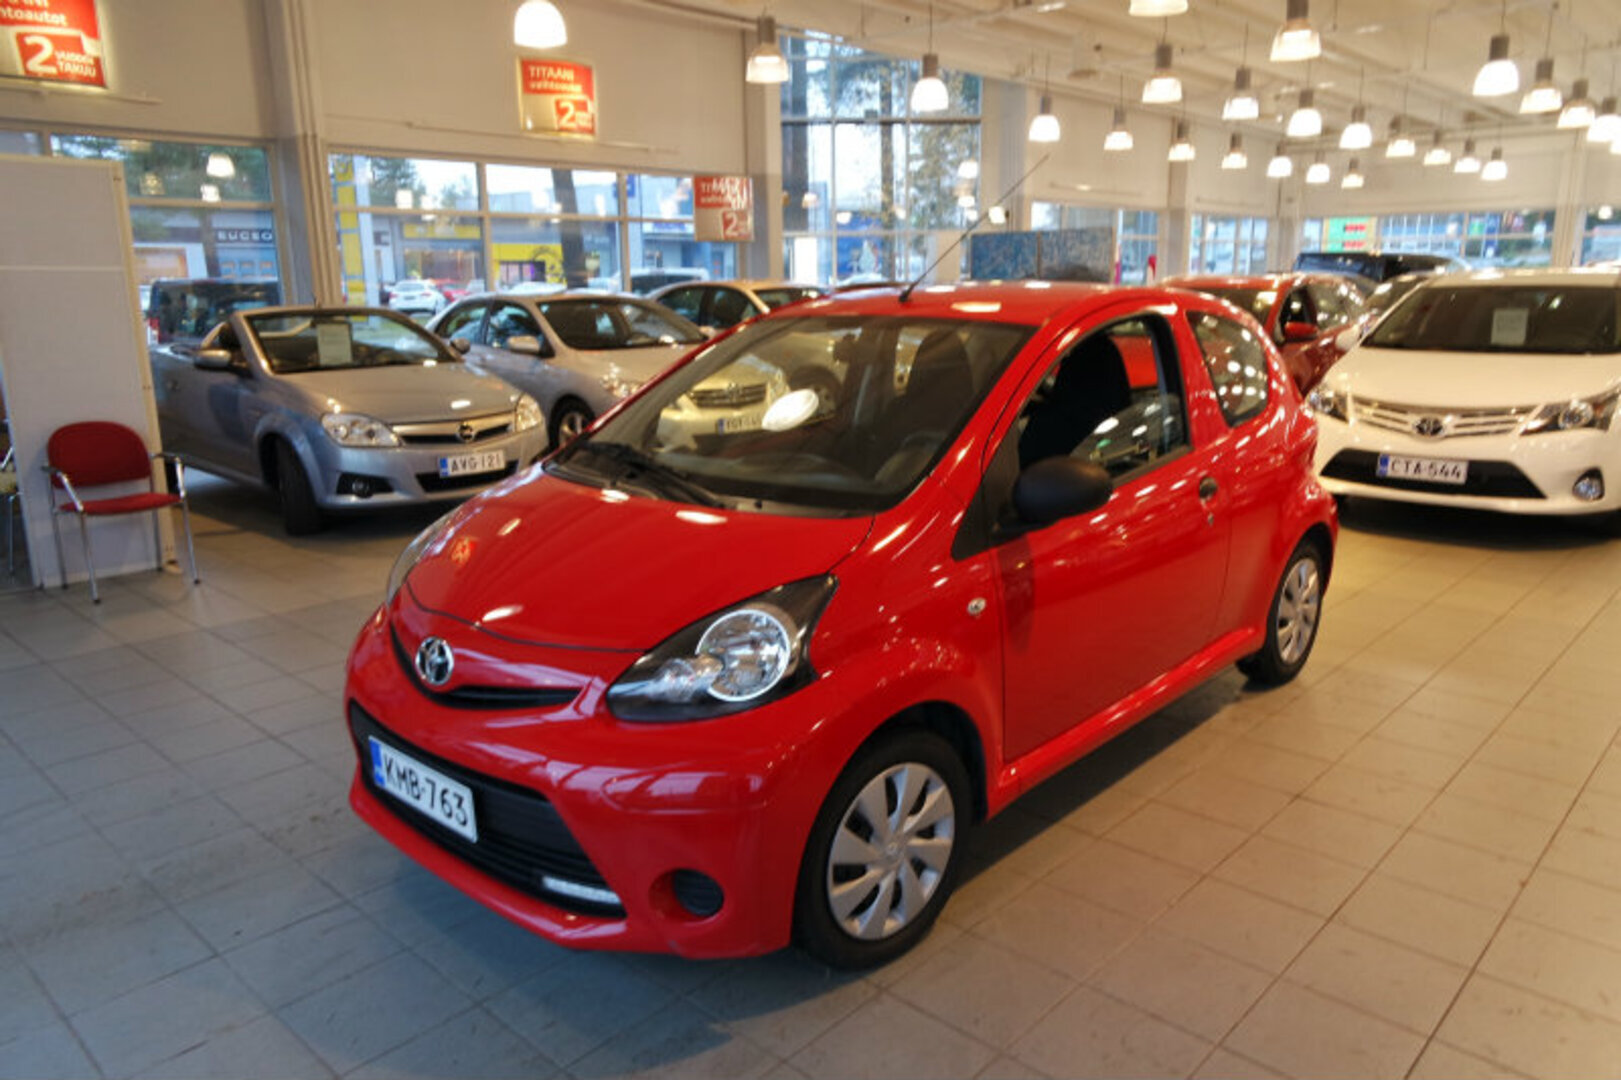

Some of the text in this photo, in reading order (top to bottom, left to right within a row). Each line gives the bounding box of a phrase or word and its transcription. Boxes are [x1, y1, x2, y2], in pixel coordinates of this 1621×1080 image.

[24, 35, 57, 74] 2
[58, 61, 96, 77] TAKUU
[528, 65, 574, 80] TITAANI
[559, 101, 576, 128] 2
[724, 210, 740, 237] 2
[383, 752, 468, 827] KMB-763
